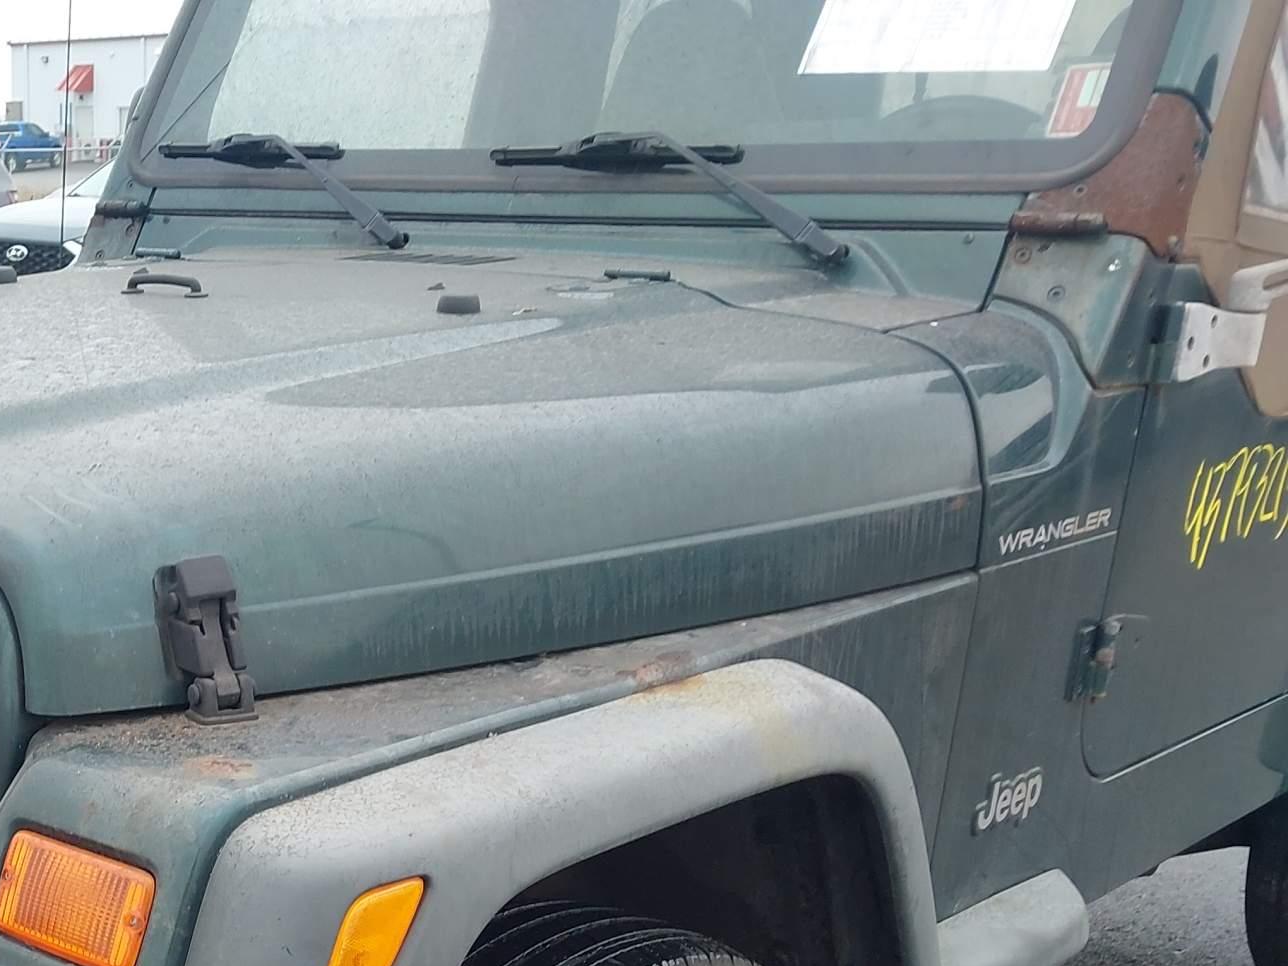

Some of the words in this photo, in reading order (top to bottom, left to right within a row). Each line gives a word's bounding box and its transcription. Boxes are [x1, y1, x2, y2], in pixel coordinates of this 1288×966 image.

[998, 507, 1112, 556] WRANGLER
[1184, 443, 1288, 569] 4379321
[976, 767, 1043, 830] Jeep
